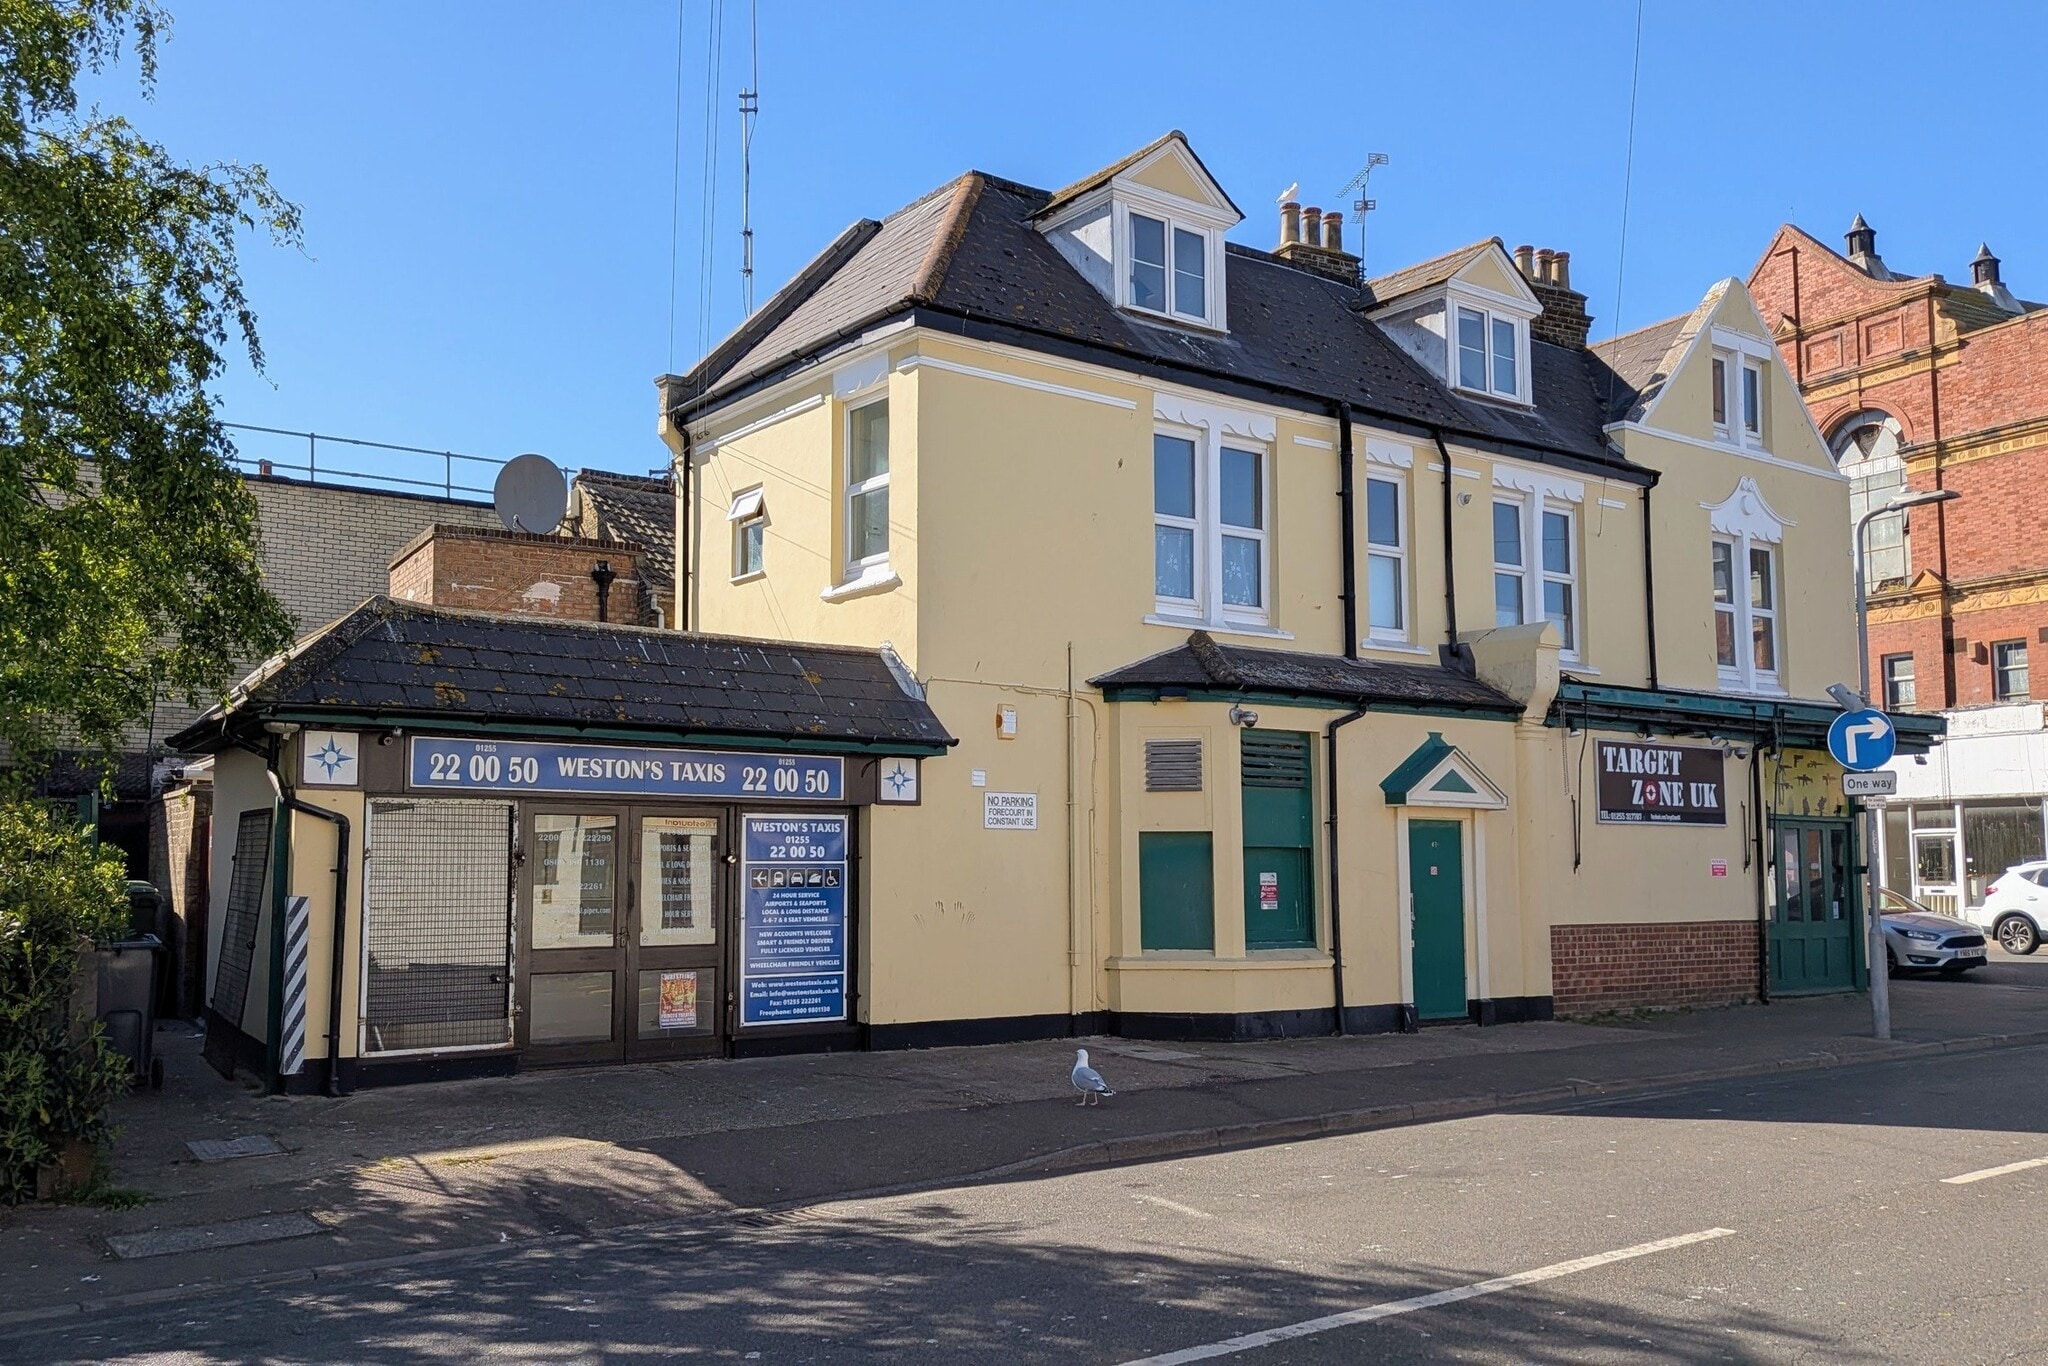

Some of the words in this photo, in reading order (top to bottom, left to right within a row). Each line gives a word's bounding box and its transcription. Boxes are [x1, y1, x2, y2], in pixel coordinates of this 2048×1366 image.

[475, 744, 497, 752] 01255
[778, 758, 796, 766] 01255
[1603, 746, 1682, 776] TARGET
[430, 753, 461, 781] 22
[469, 754, 500, 782] 00
[508, 756, 539, 784] 50
[557, 756, 664, 781] WESTON'S
[670, 761, 726, 783] TAXIS
[742, 766, 767, 791] 22
[773, 767, 799, 793] 00
[804, 769, 829, 794] 50
[1847, 778, 1869, 789] One
[1871, 779, 1893, 790] way
[1631, 779, 1685, 807] ZONE
[1689, 782, 1719, 808] UK
[987, 796, 999, 806] NO
[1001, 797, 1034, 807] PARKING
[988, 808, 1026, 817] FORECOURT
[1026, 809, 1033, 817] IN
[987, 817, 1020, 826] CONSTANT
[1021, 818, 1034, 826] USE
[751, 822, 808, 833] WESTON'S
[810, 823, 841, 833] TAXIS
[785, 836, 810, 844] 01255
[769, 845, 786, 858] 22
[789, 846, 806, 858] 00
[809, 846, 825, 858] 50
[585, 858, 605, 866] 1130
[574, 882, 603, 890] 22261
[759, 1009, 792, 1017] Freephone:
